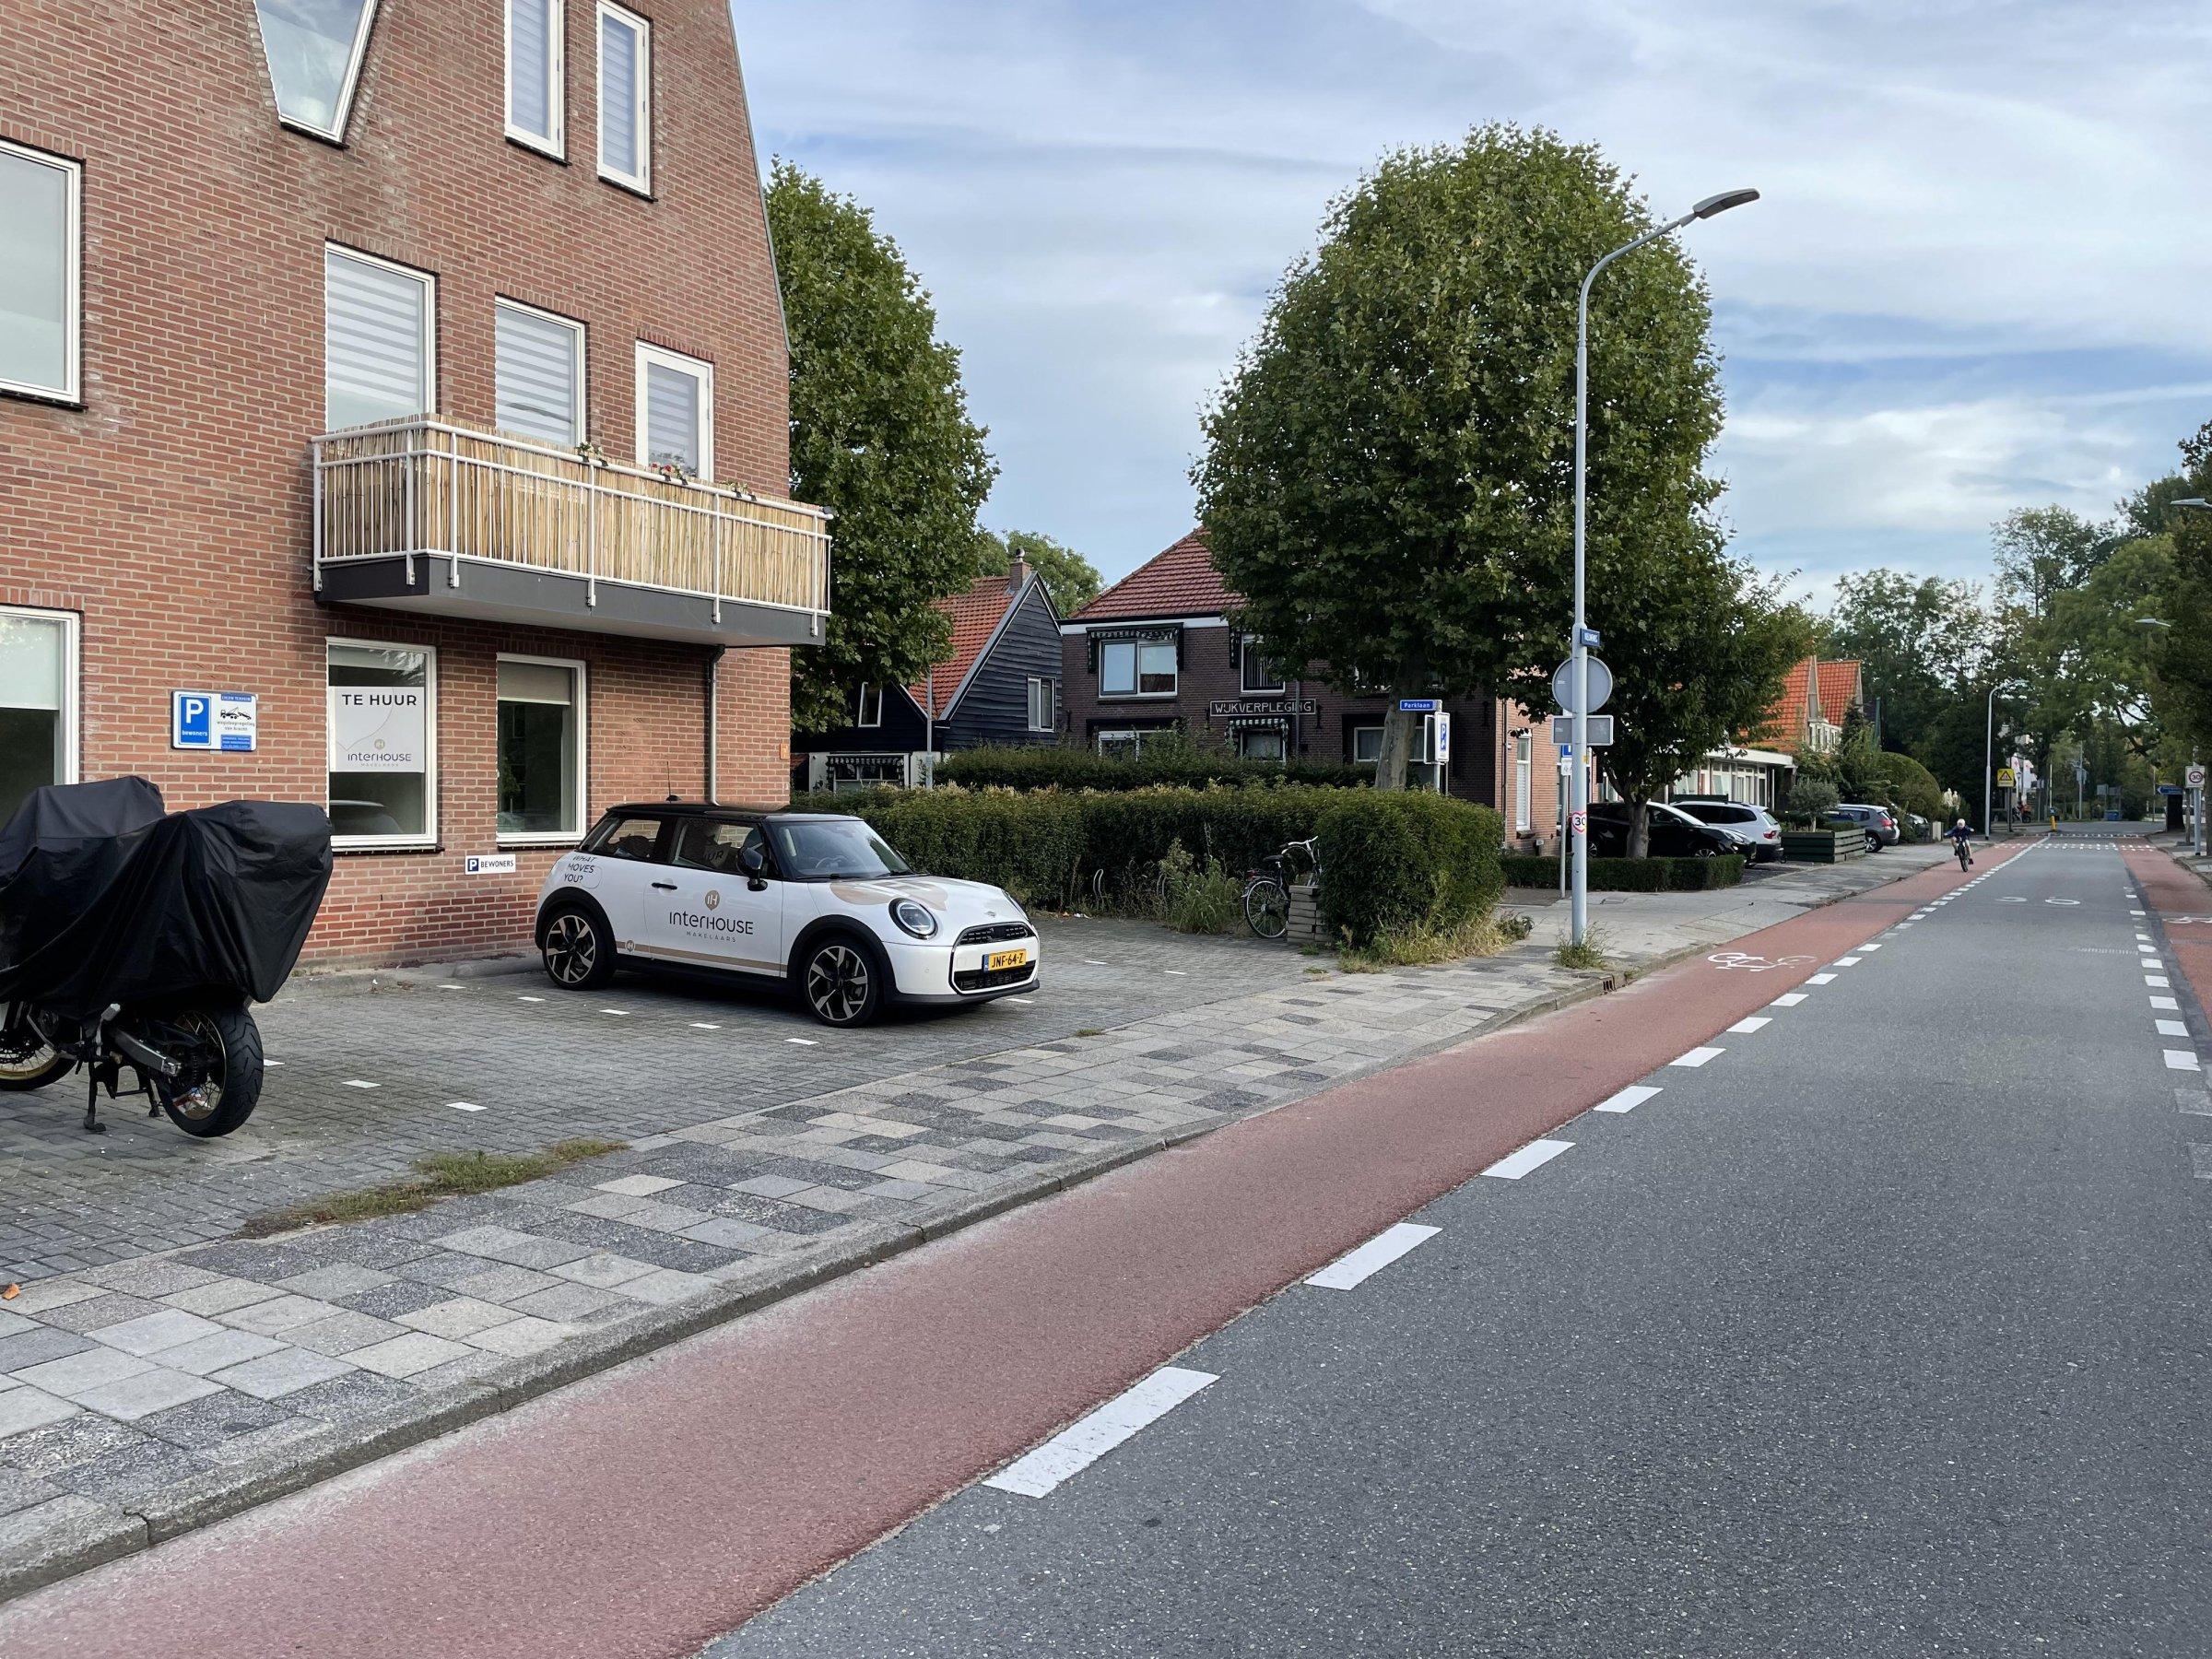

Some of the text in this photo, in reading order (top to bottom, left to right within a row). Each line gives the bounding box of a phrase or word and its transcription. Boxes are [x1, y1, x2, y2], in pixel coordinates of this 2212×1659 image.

[342, 694, 417, 706] TE HUUR
[186, 699, 204, 724] P
[572, 854, 596, 863] WHAT
[469, 859, 514, 871] P BEWONERS
[567, 863, 595, 874] MOVES
[564, 873, 583, 883] YOU?
[686, 931, 736, 943] MAKELAARS
[992, 952, 1024, 968] JNF-64-Z
